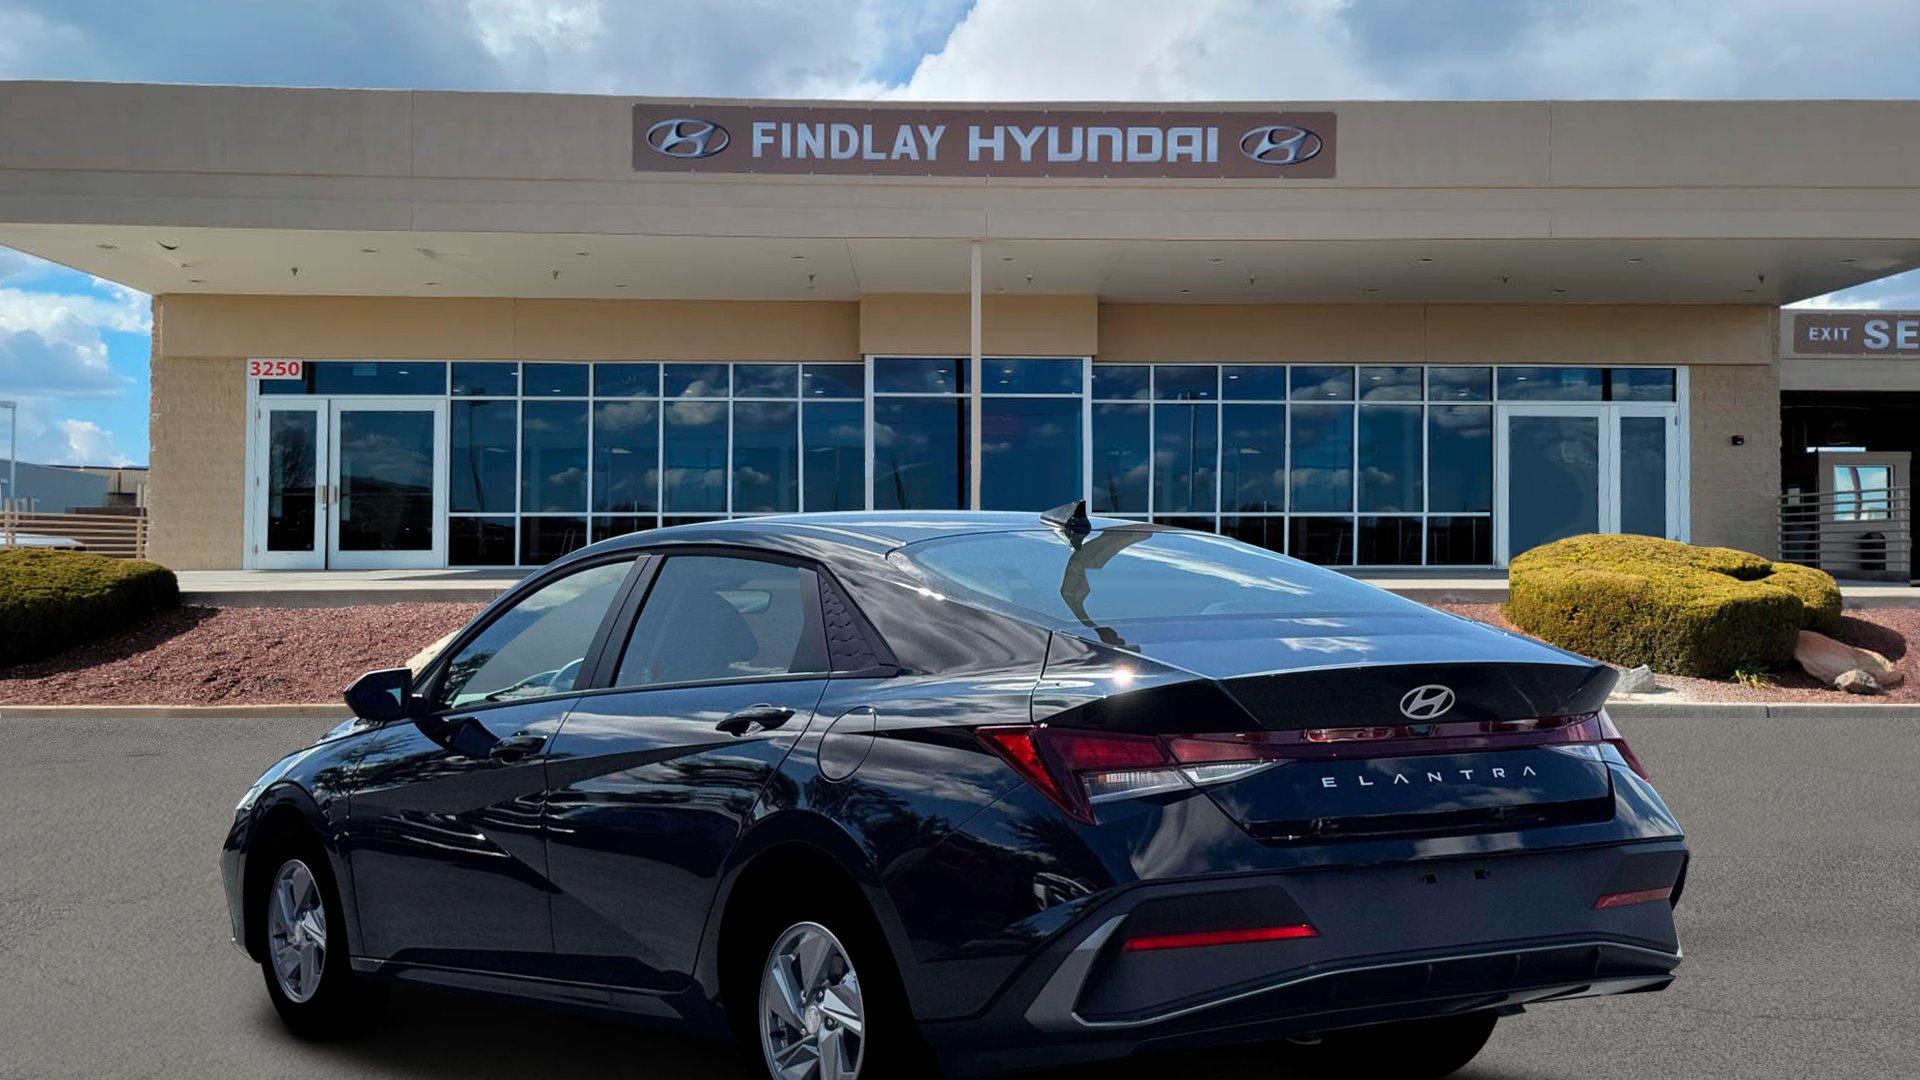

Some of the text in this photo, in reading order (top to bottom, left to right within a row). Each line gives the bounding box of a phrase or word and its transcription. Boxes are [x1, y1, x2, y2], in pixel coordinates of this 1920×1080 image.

[751, 122, 1219, 162] FINDLAY HYUNDAI
[1809, 319, 1919, 350] EXIT SE
[250, 361, 300, 376] 3250
[1321, 765, 1537, 788] ELANTRA
